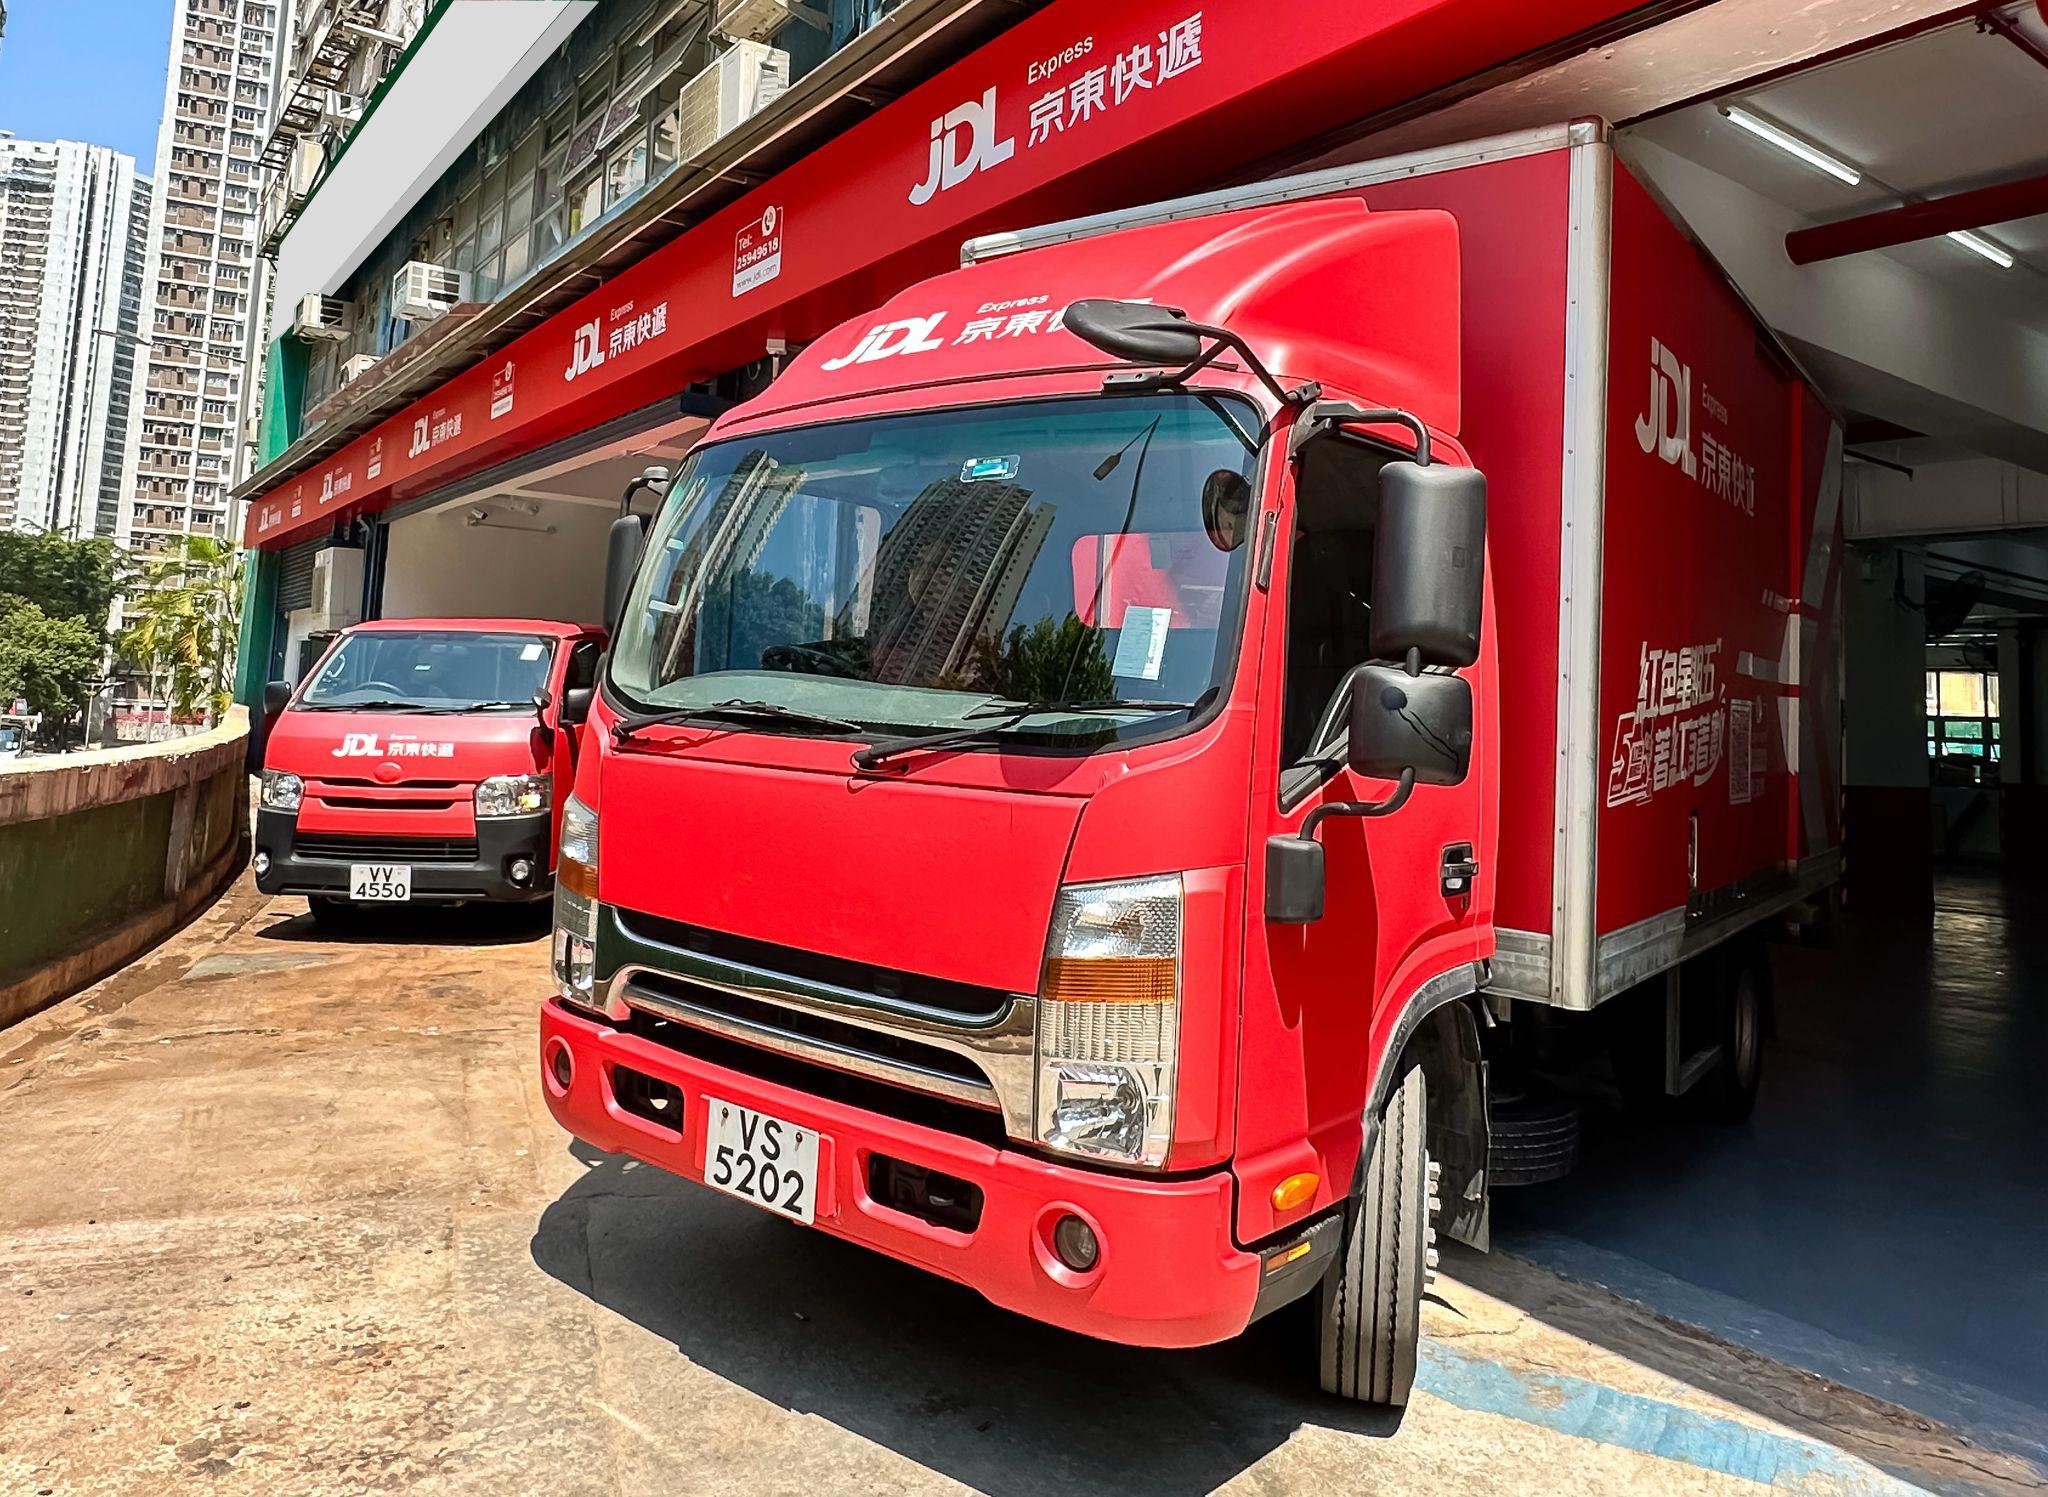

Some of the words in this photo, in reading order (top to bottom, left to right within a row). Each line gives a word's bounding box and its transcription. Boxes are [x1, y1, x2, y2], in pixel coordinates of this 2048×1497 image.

[1027, 36, 1094, 85] Express
[1028, 11, 1202, 148] 京東快遞
[908, 86, 1015, 206] JDL
[609, 302, 668, 359] 京東快遞
[977, 294, 1050, 315] Express
[564, 317, 605, 381] JDL
[820, 311, 948, 371] JDL
[1634, 335, 1697, 481] JDL
[331, 733, 384, 757] JDL
[355, 882, 406, 899] 4550
[369, 866, 393, 882] VV
[739, 1109, 783, 1161] VS
[713, 1144, 804, 1216] 5202
